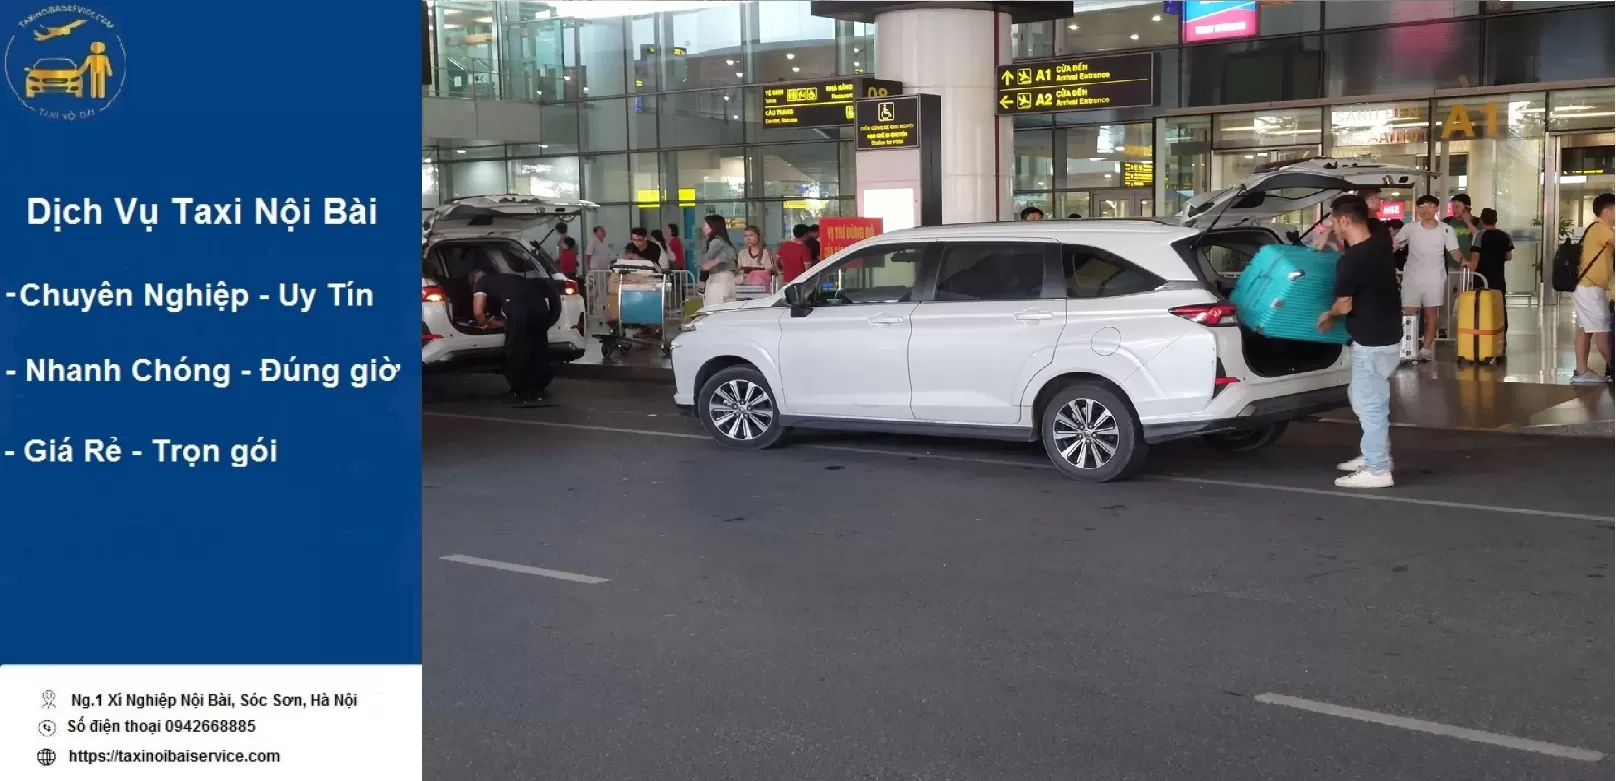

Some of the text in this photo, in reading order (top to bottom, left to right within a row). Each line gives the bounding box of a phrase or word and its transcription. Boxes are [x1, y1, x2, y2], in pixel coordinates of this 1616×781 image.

[1035, 69, 1051, 81] A1
[1079, 72, 1110, 80] Entrance
[1035, 93, 1052, 106] A2
[1056, 97, 1110, 106] Arrival Entrance
[1441, 100, 1498, 139] A1
